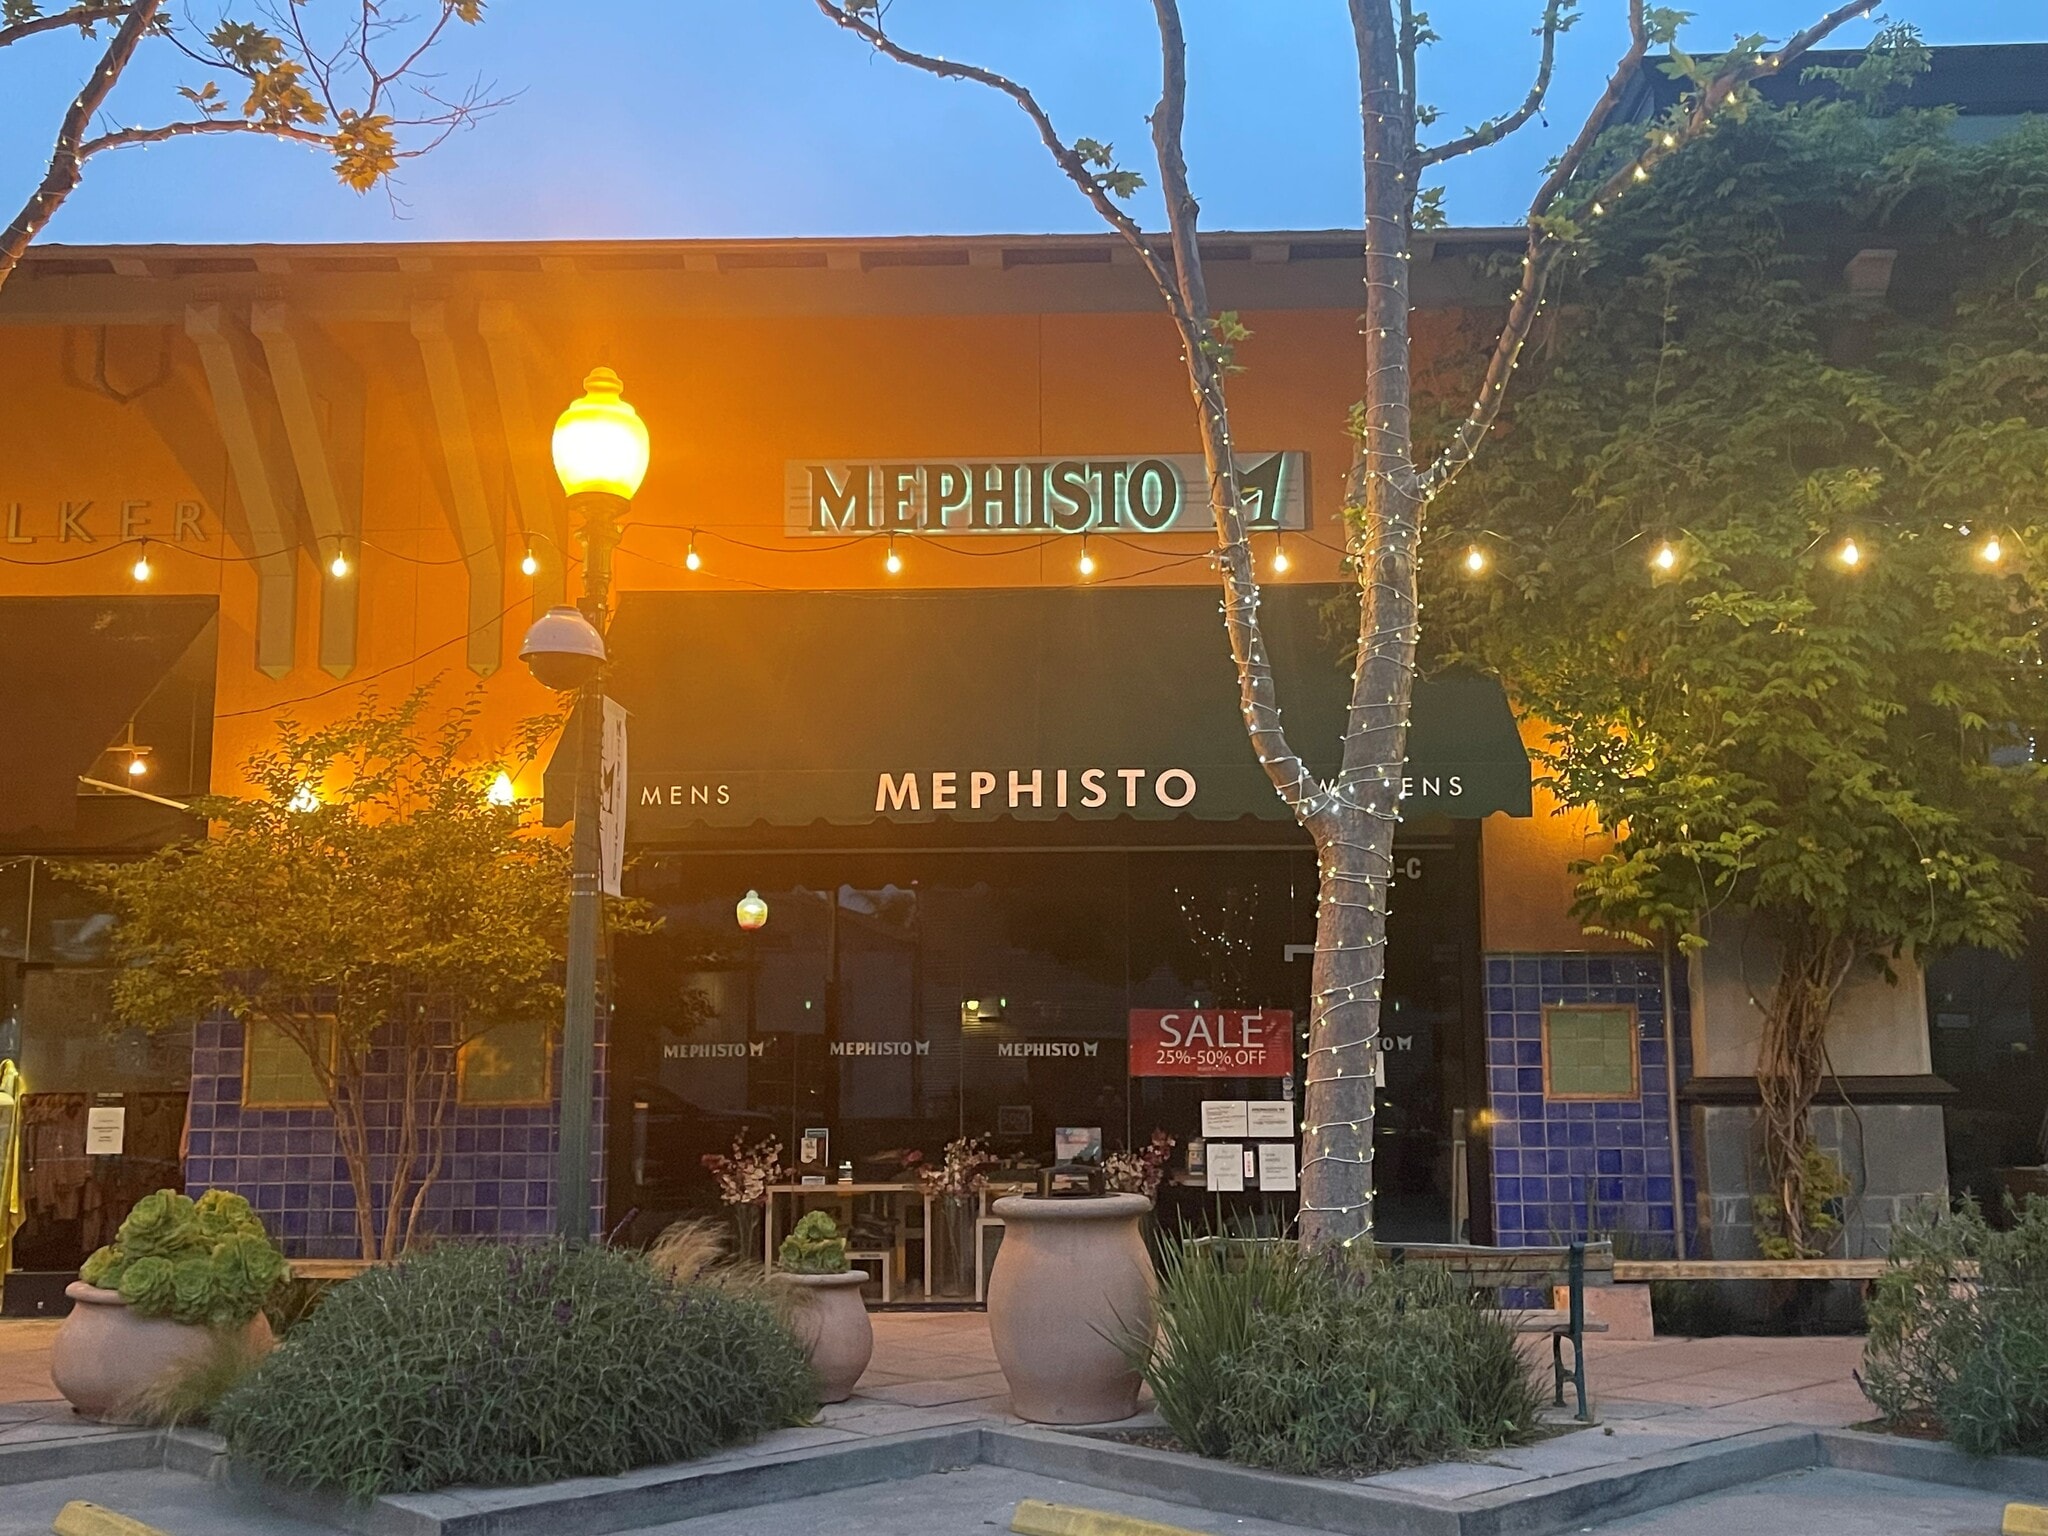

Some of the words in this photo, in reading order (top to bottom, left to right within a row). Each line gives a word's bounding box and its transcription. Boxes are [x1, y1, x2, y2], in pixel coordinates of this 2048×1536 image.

[806, 459, 1178, 531] MEPHISTO
[641, 785, 731, 806] MENS
[875, 769, 1197, 812] MEPHISTO
[1159, 1014, 1265, 1048] SALE
[664, 1044, 745, 1058] MEPHISTO
[830, 1042, 911, 1056] MEPHISTO
[998, 1043, 1079, 1057] MEPHISTO
[1156, 1050, 1232, 1065] 25%-50%
[1235, 1050, 1267, 1065] OFF
